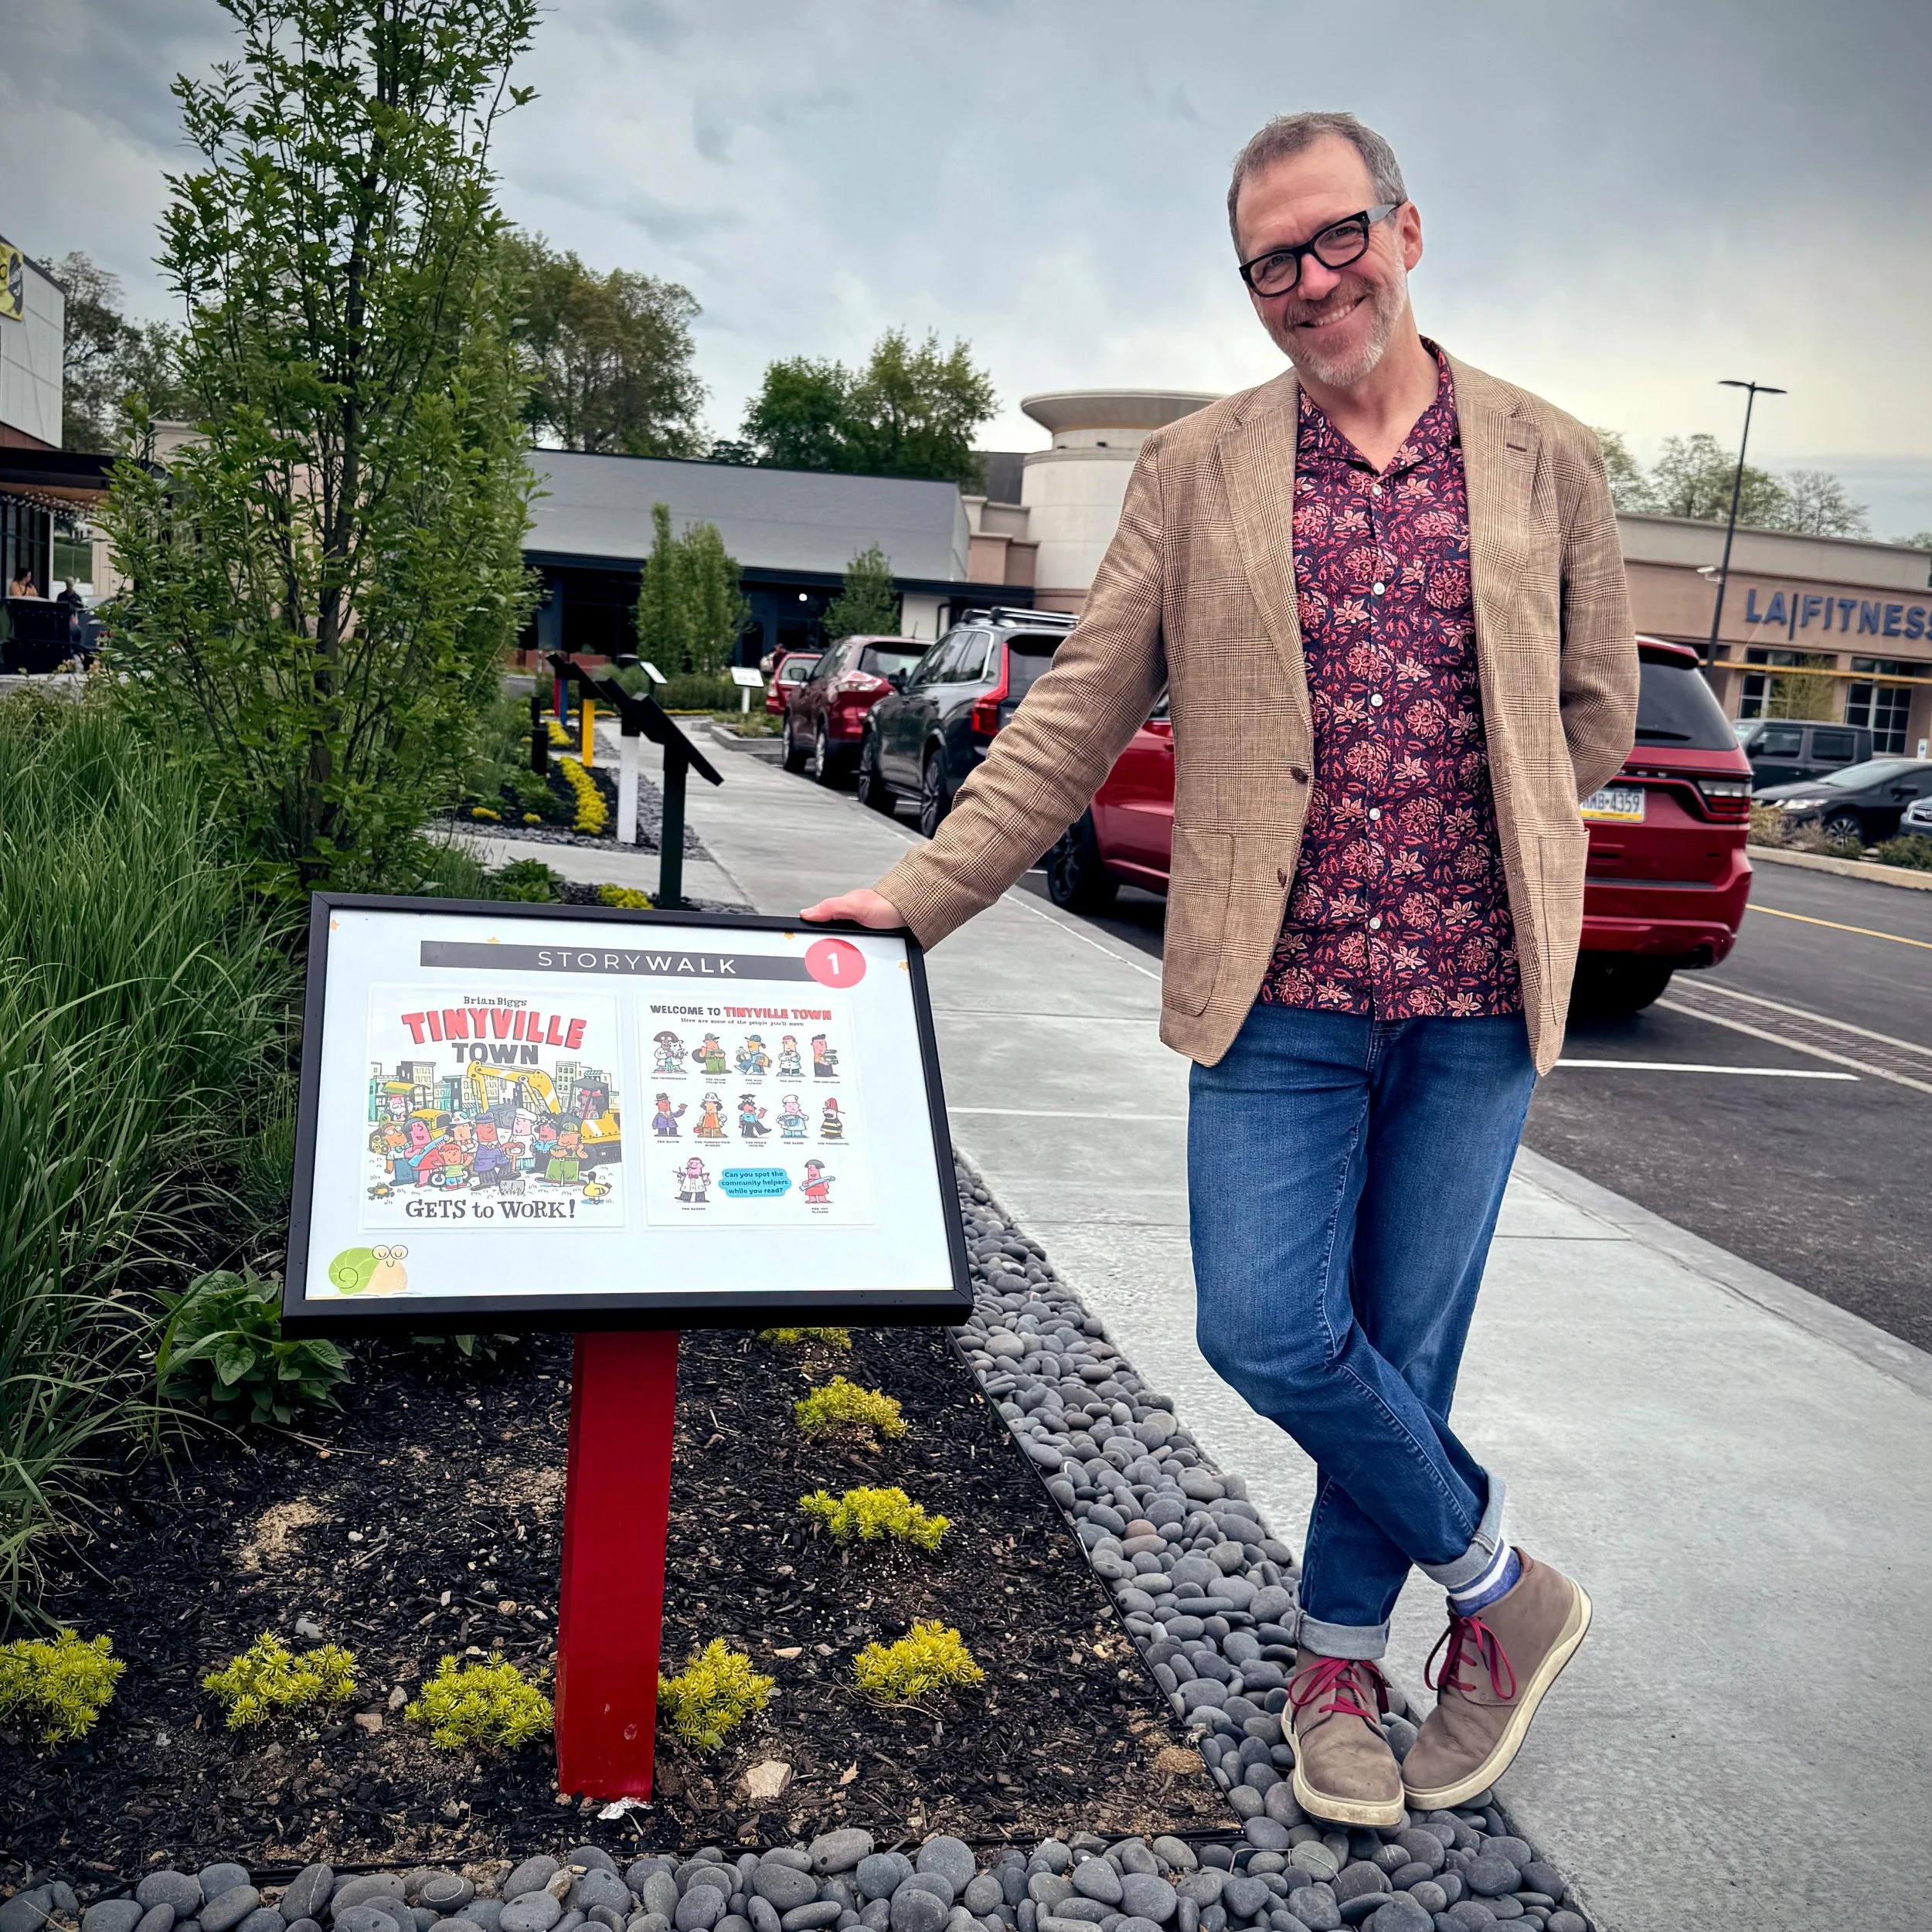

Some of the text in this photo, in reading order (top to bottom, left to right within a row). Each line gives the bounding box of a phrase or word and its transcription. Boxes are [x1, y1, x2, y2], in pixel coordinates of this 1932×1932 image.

[1800, 594, 1932, 640] FITNES
[538, 951, 736, 975] STORYWALK
[827, 953, 840, 975] 1
[463, 996, 528, 1008] Brian Biggs
[650, 1005, 832, 1020] WELCOME TO TINYVILLE TOWN
[401, 1008, 587, 1049] TINYVILLE
[451, 1043, 539, 1065] TOWN
[754, 1171, 770, 1179] spot
[471, 1202, 495, 1219] to
